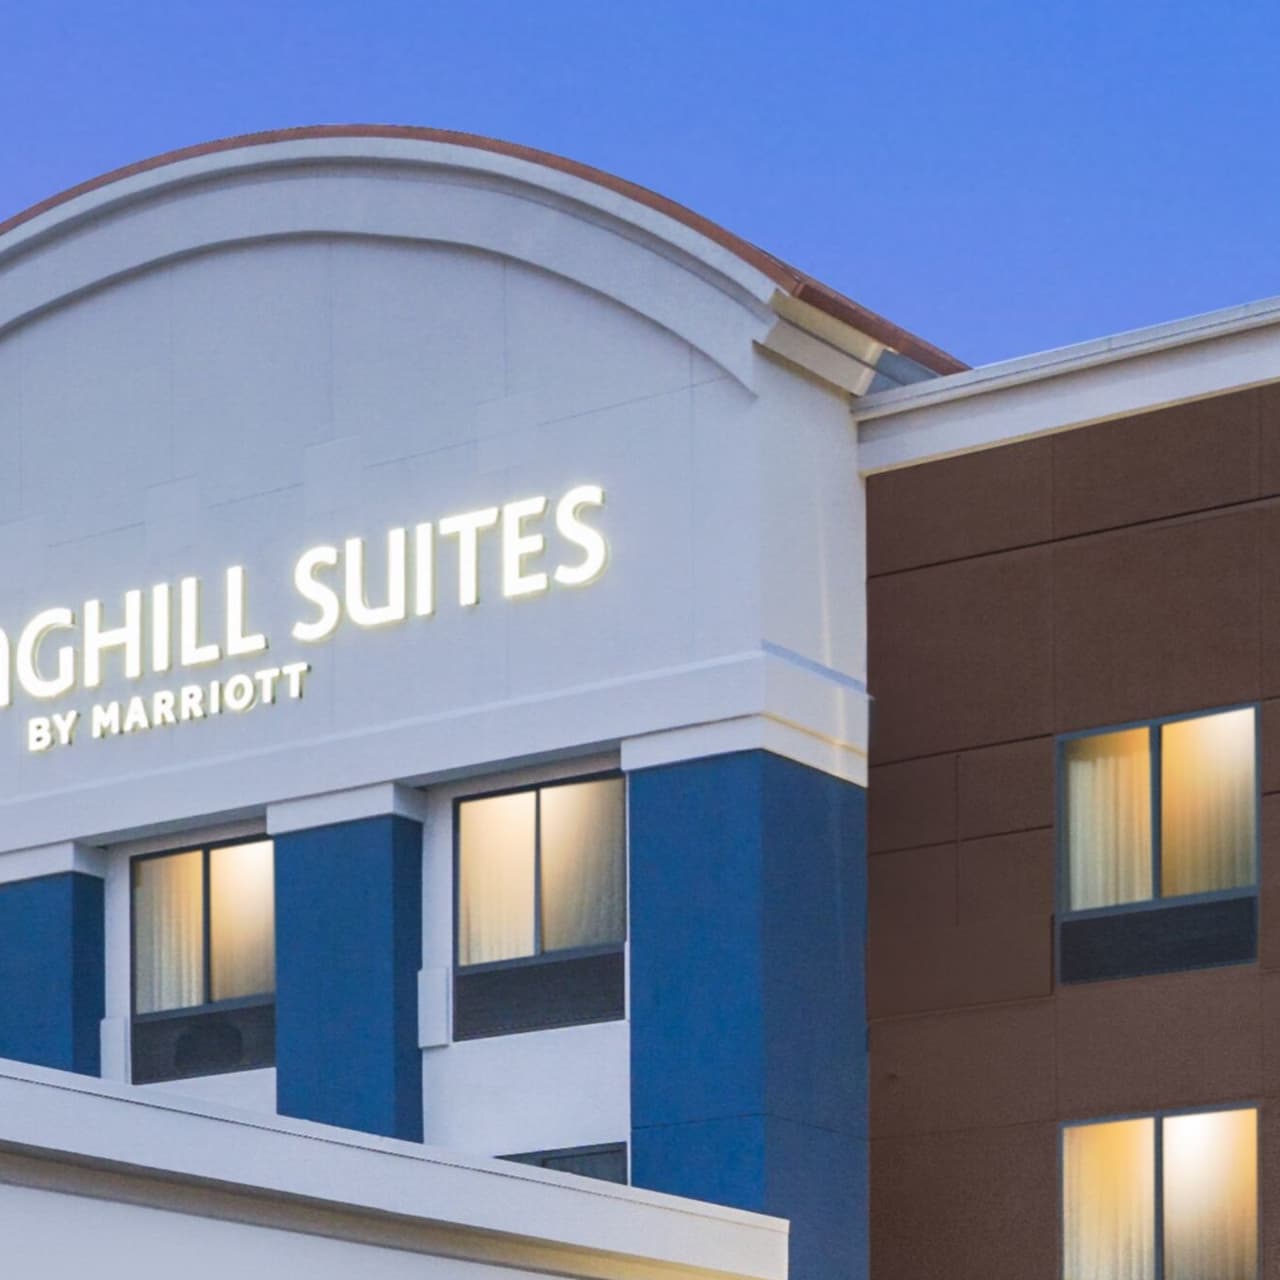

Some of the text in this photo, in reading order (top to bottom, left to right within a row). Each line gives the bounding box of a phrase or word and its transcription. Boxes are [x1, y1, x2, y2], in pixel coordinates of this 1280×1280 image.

[291, 484, 608, 643] SUITES
[27, 661, 311, 752] BY MARRIOTT
